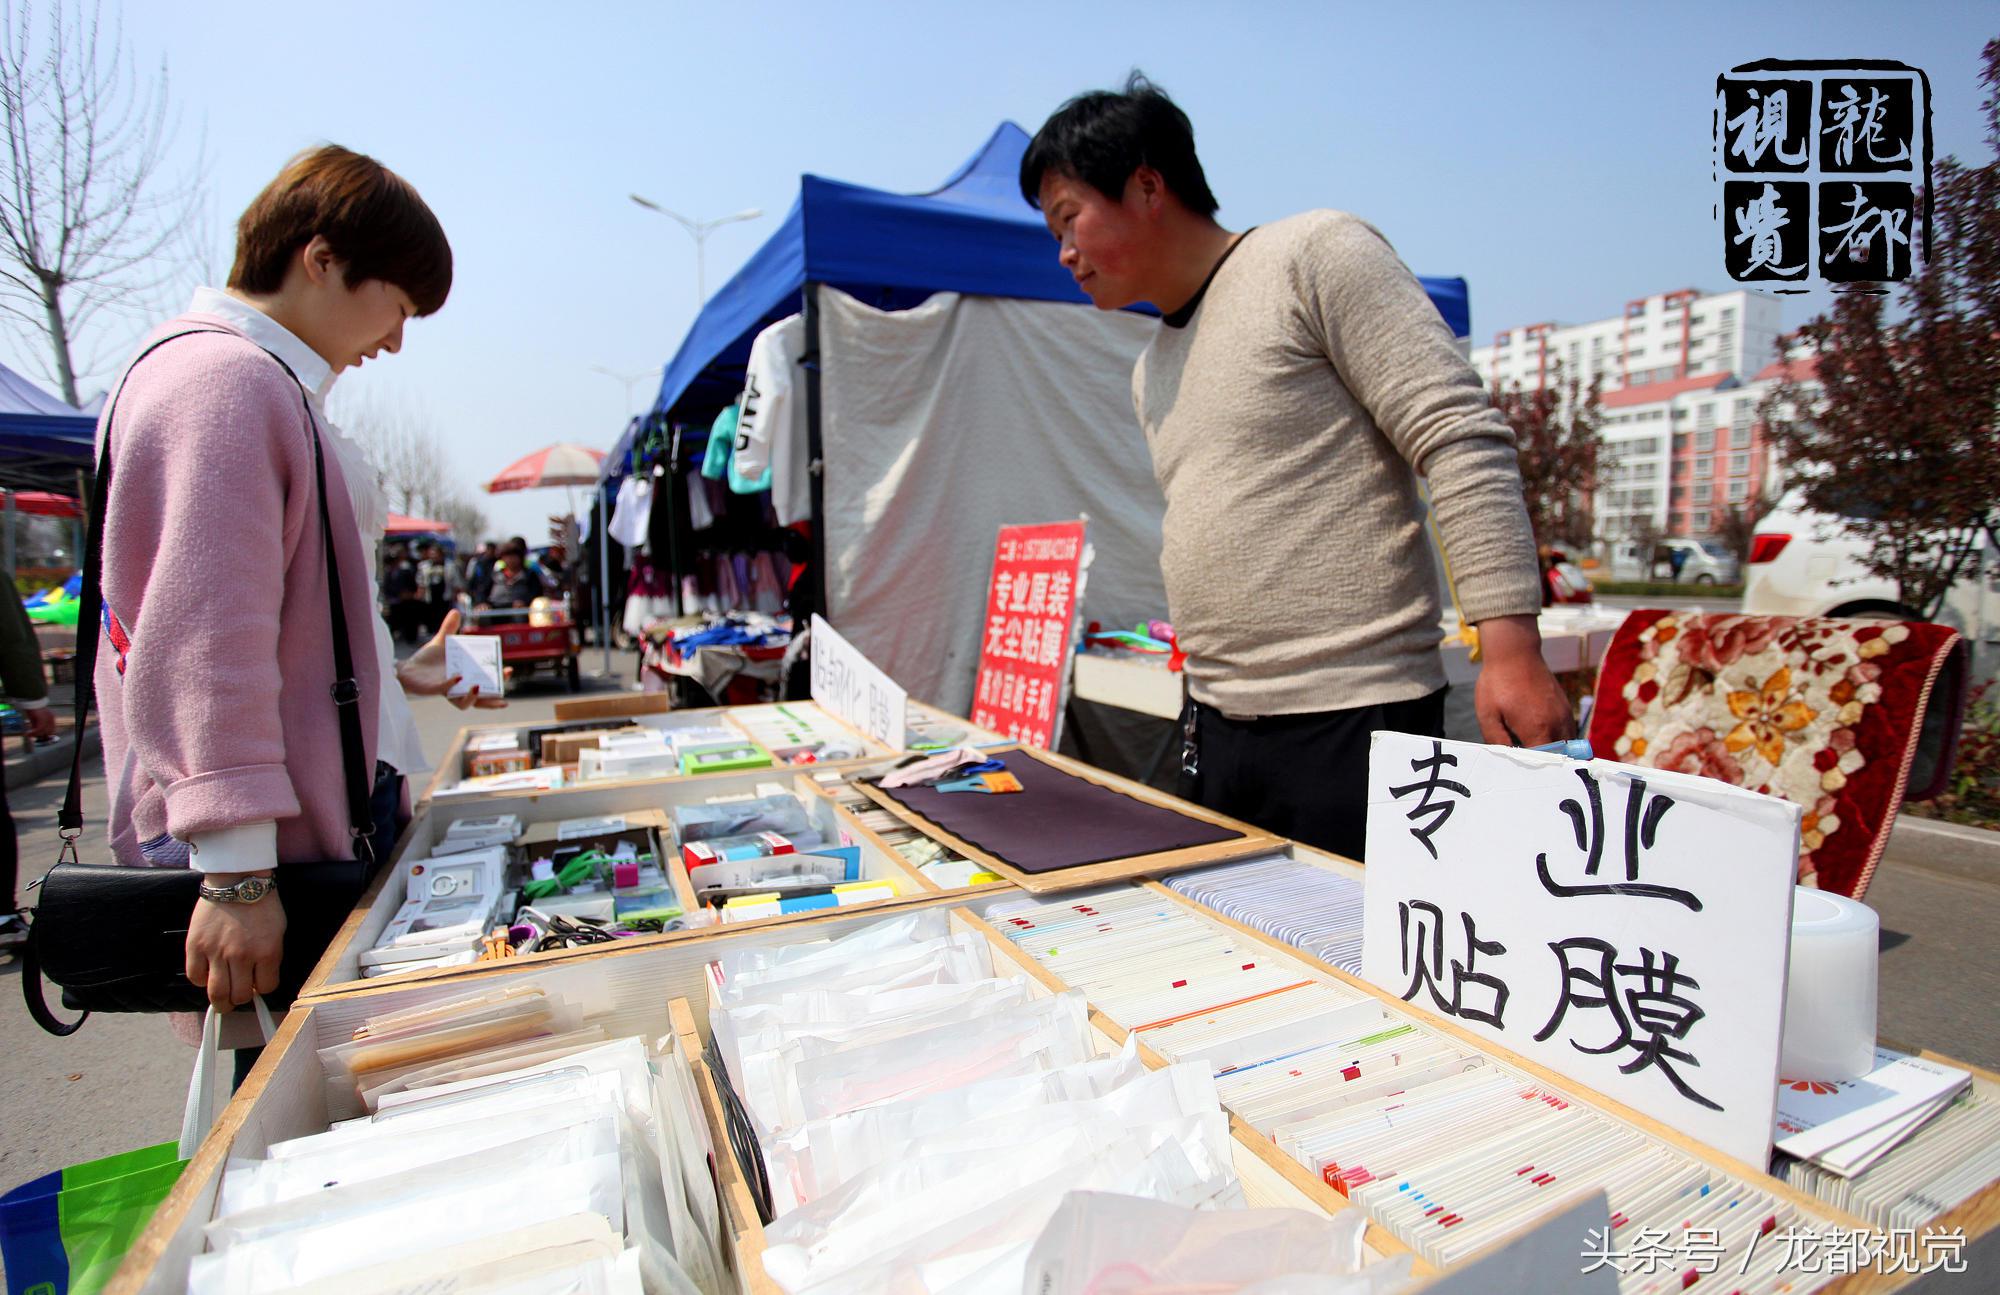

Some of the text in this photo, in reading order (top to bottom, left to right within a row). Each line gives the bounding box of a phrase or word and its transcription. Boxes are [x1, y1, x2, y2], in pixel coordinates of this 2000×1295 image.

[995, 568, 1072, 618] 专业原装
[985, 614, 1064, 667] 无尘贴膜
[978, 668, 1053, 722] 高价回收手机
[1389, 739, 1704, 912] 专业
[1397, 898, 1725, 1112] 贴膜
